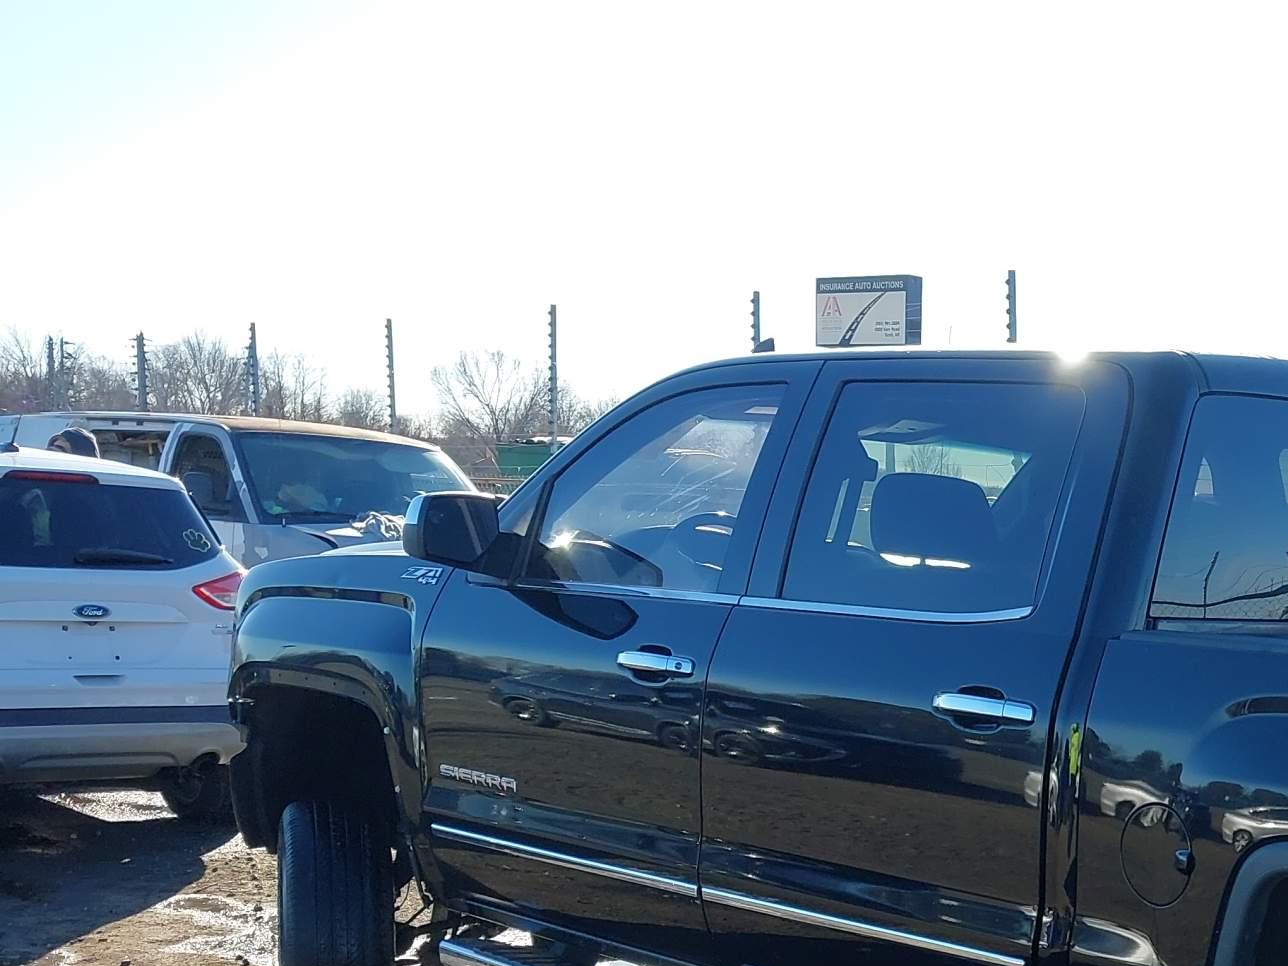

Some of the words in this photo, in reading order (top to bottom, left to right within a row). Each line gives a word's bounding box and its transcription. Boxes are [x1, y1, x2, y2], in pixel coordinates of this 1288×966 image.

[819, 282, 854, 291] INSURANCE
[854, 281, 872, 290] AUTO
[872, 280, 904, 289] AUCTIONS
[439, 763, 517, 793] SIERRA
